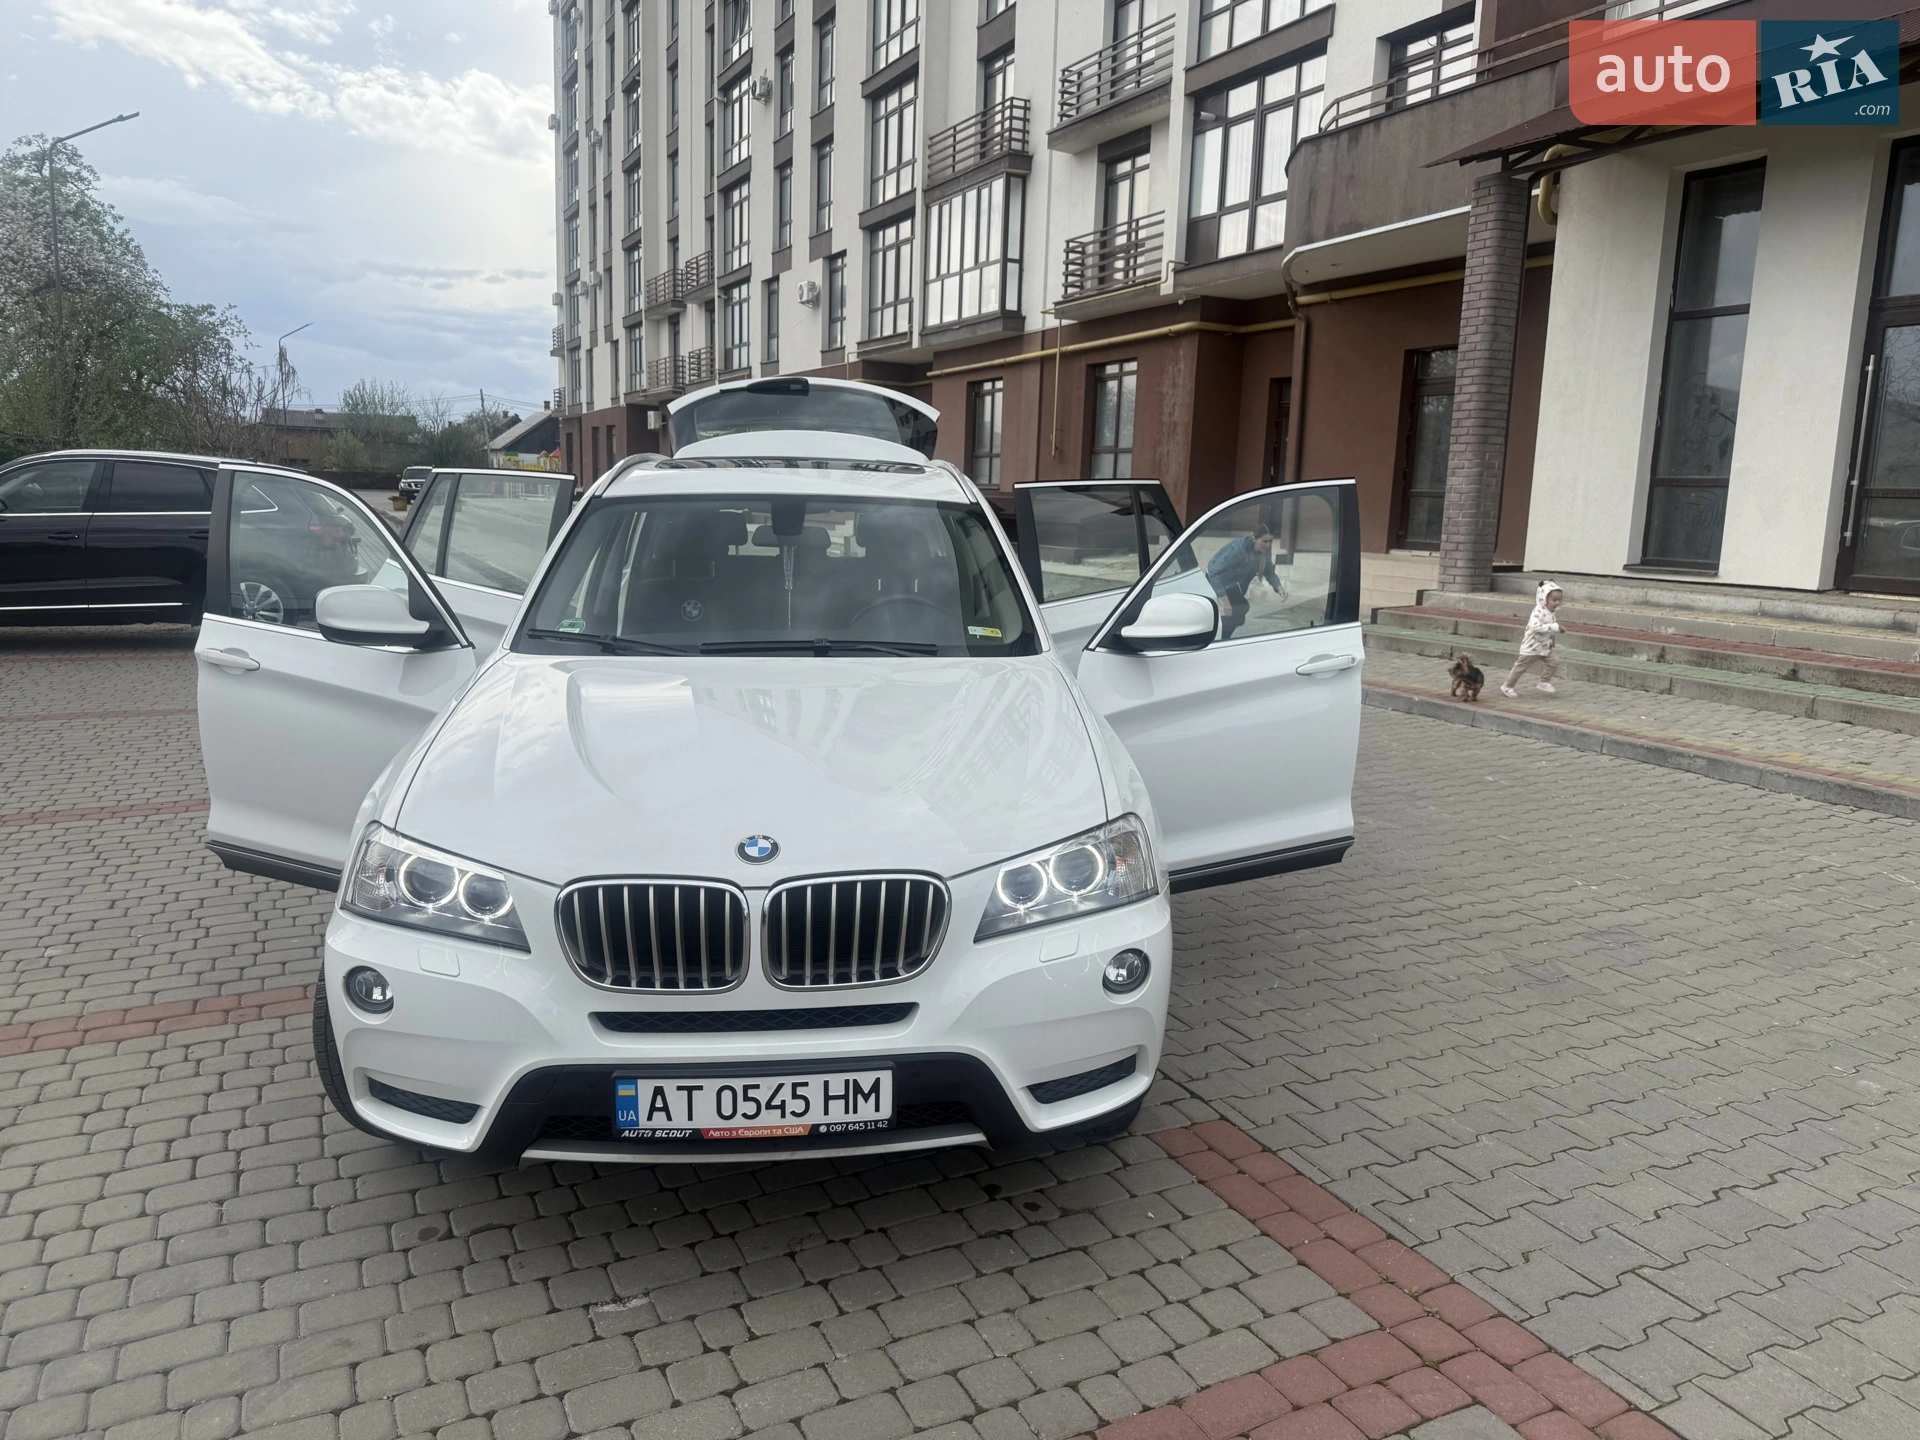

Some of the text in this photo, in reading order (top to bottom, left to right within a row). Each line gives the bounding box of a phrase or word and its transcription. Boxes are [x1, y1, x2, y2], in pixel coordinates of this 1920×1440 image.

[646, 1076, 881, 1122] AT 0545 HM
[618, 1109, 637, 1122] UA
[708, 1129, 730, 1137] Авто
[738, 1128, 770, 1137] Європи
[783, 1126, 804, 1134] США
[829, 1120, 889, 1132] 097 645 11 42
[621, 1129, 693, 1138] AUTO SCOUT
